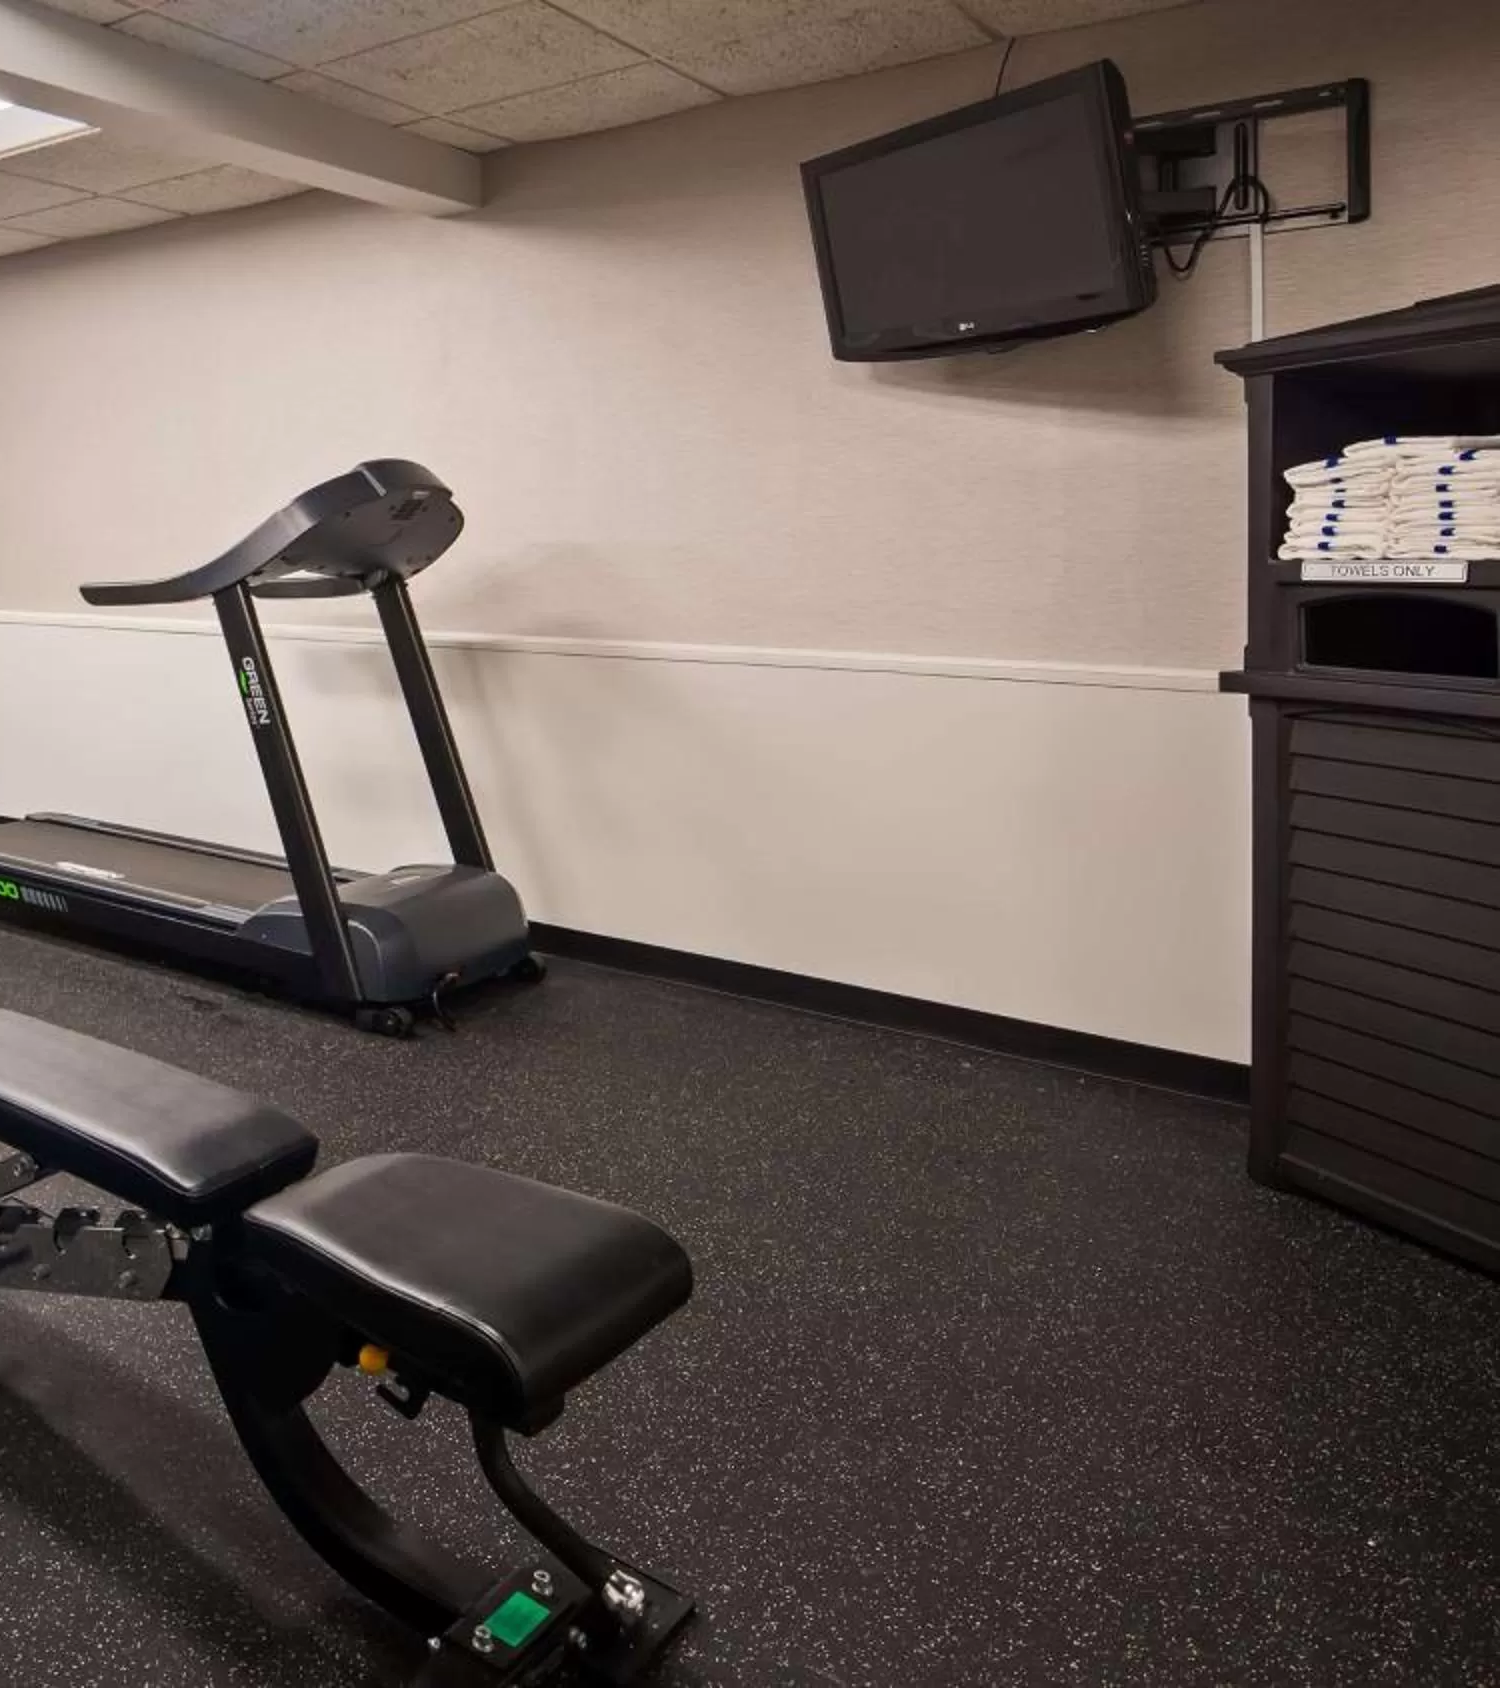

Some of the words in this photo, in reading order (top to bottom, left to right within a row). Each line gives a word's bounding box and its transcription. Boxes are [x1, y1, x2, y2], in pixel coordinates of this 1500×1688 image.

[1331, 564, 1389, 577] TOWELS
[1394, 564, 1435, 577] ONLY
[242, 656, 271, 725] GREEN
